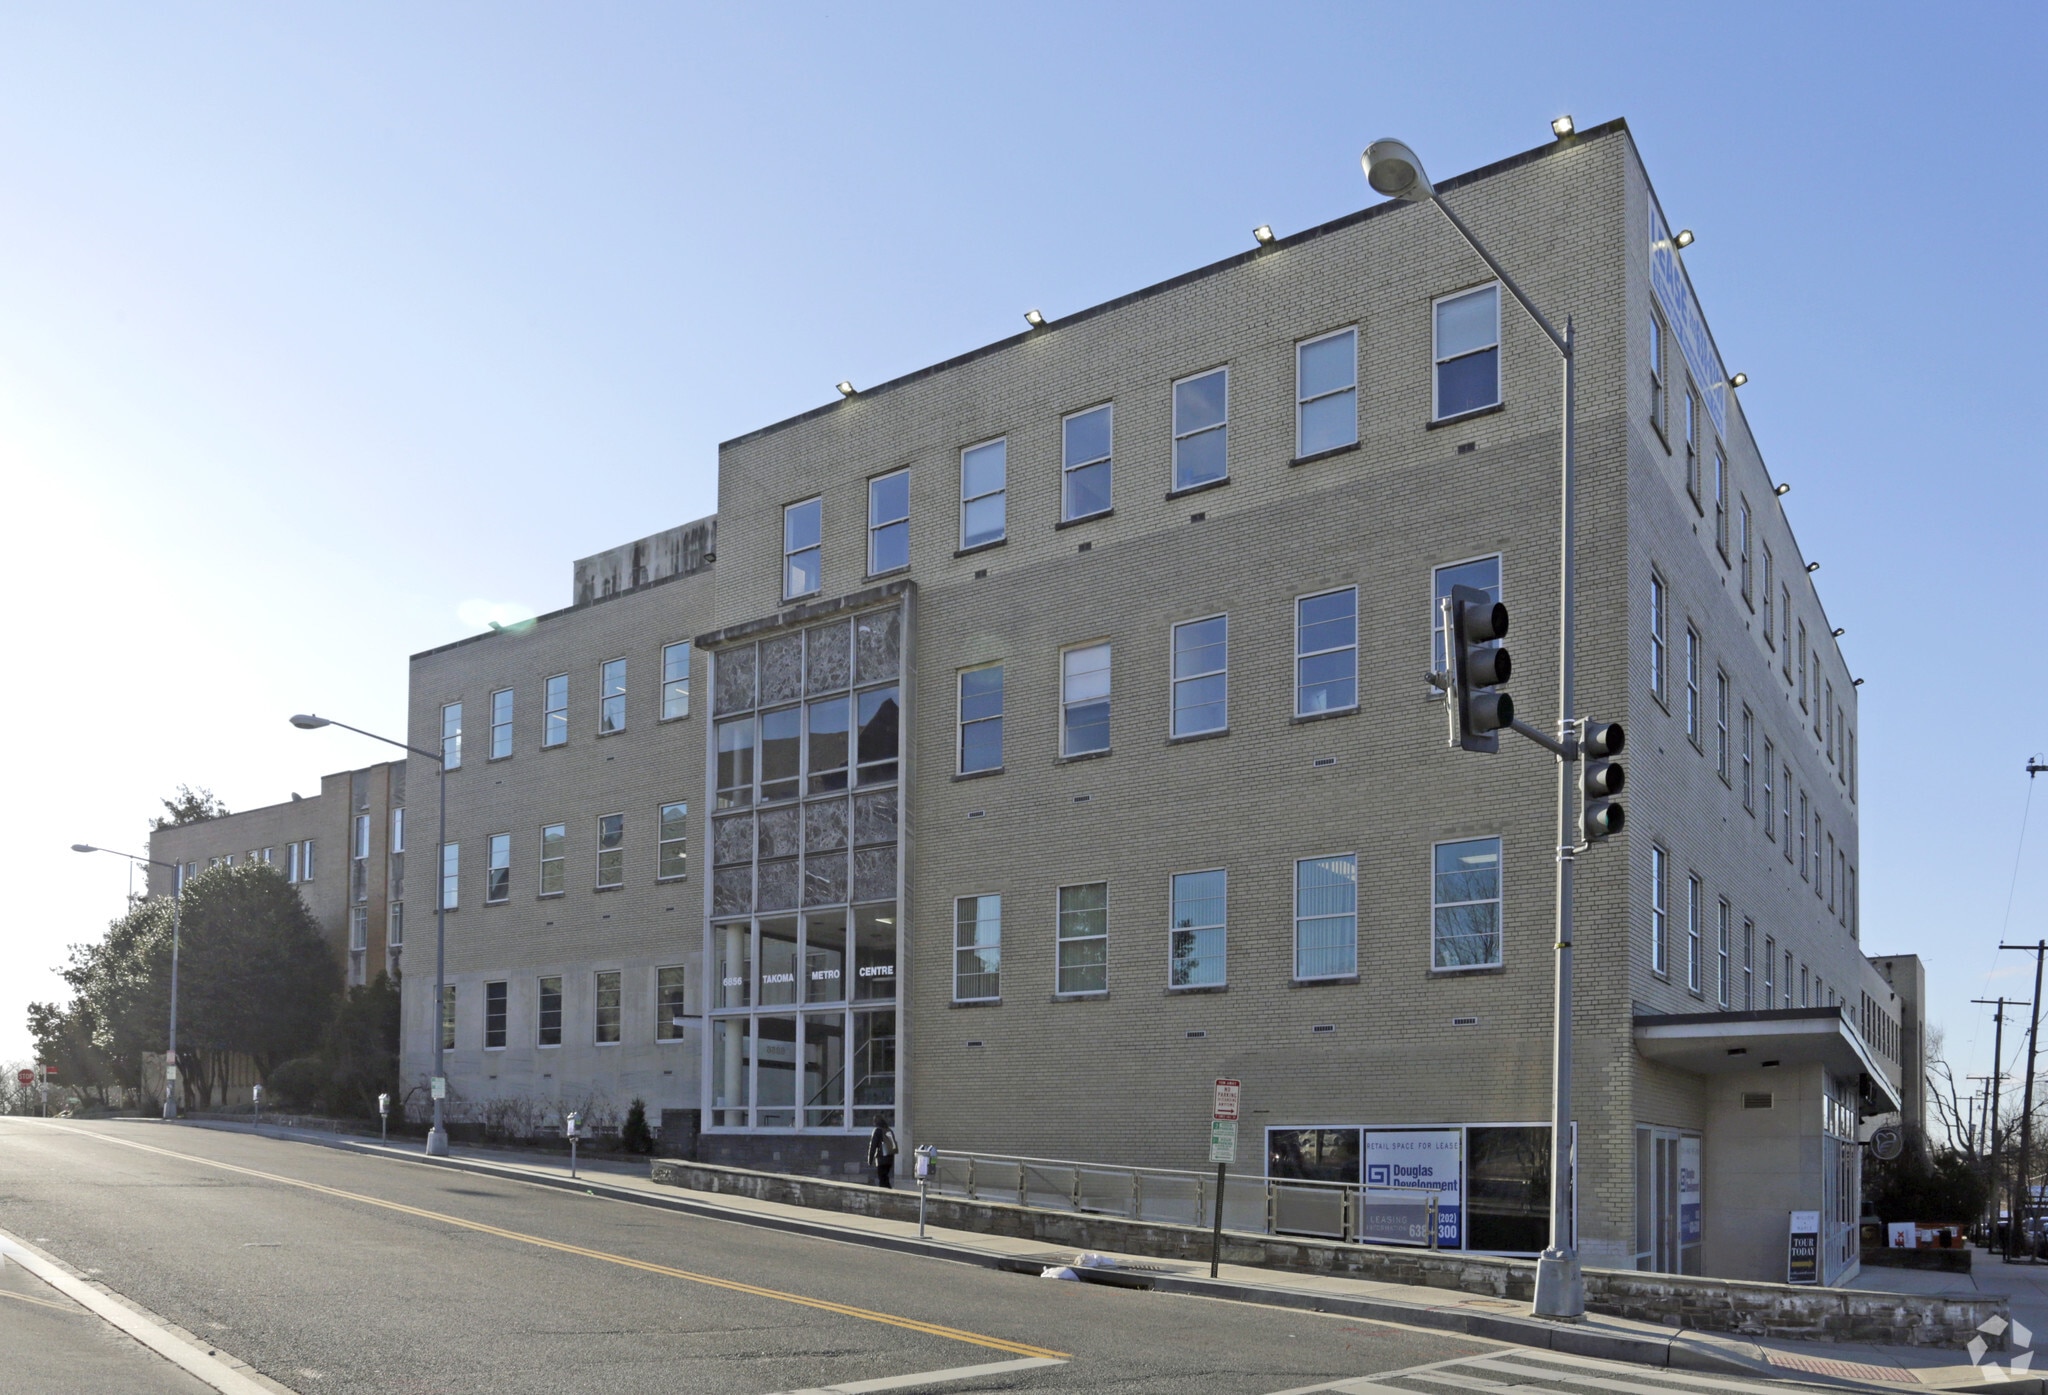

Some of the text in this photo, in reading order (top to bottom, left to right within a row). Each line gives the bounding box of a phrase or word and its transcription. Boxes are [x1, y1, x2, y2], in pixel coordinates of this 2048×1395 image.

[723, 965, 894, 986] 6856 TAKOMA METRO CENTRE
[1367, 1142, 1390, 1150] RETAIL
[1392, 1142, 1414, 1150] SPACE
[1393, 1164, 1433, 1178] Douglas
[1393, 1179, 1458, 1193] Development
[1370, 1216, 1408, 1224] LEASING
[1438, 1213, 1457, 1224] (202)
[1794, 1238, 1814, 1247] TOUR
[1791, 1247, 1815, 1256] TODAY
